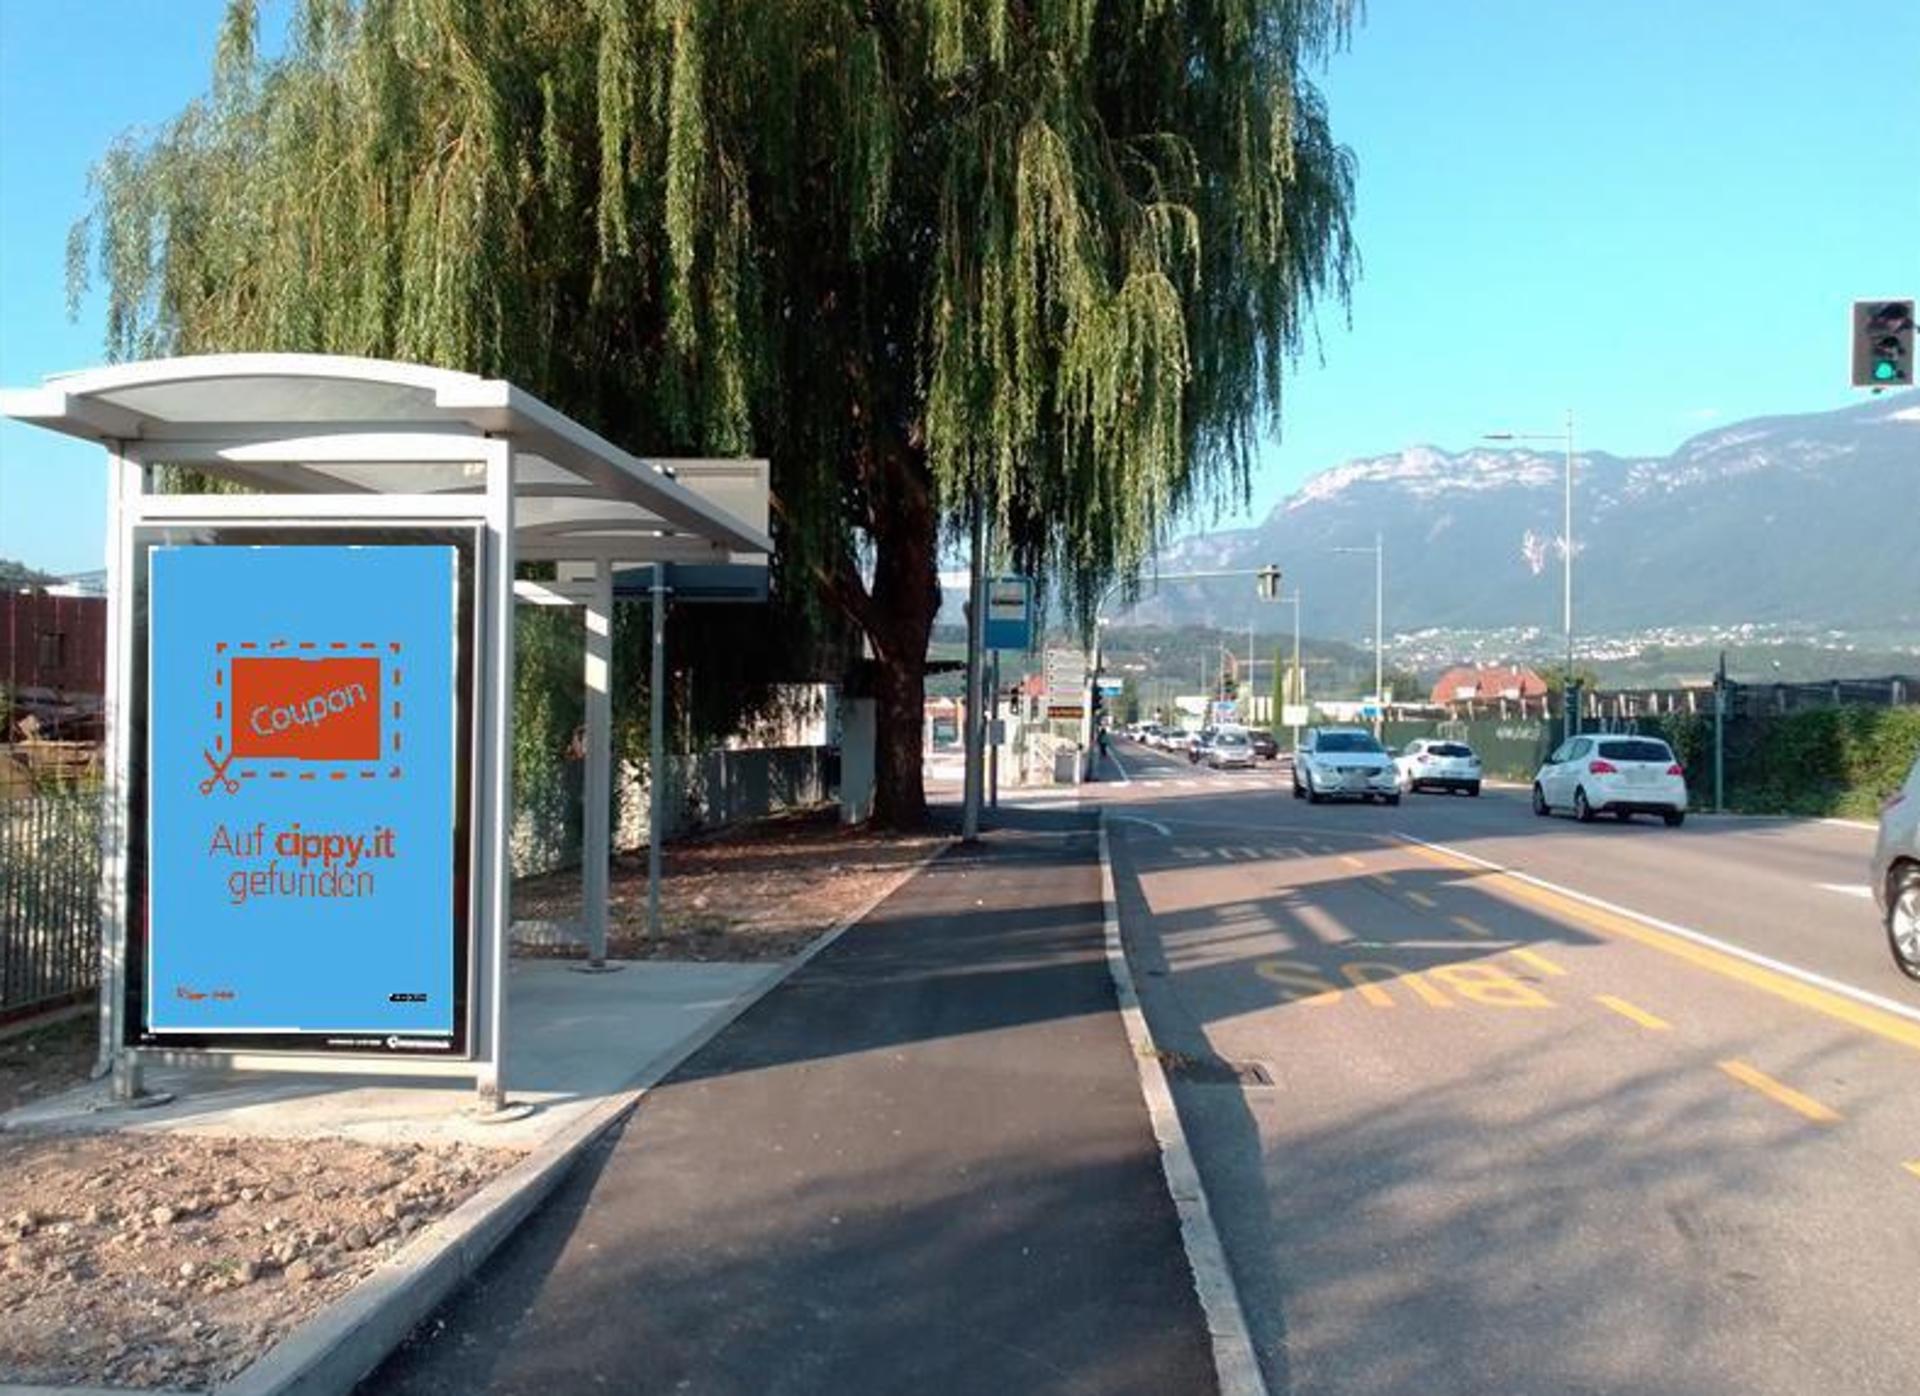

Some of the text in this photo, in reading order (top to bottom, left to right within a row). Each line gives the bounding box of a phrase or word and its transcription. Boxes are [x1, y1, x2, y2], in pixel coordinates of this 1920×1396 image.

[251, 682, 367, 737] Coupon
[209, 822, 396, 868] Auf cippy.it
[228, 859, 374, 905] gefunden
[1255, 960, 1558, 1008] BUS
